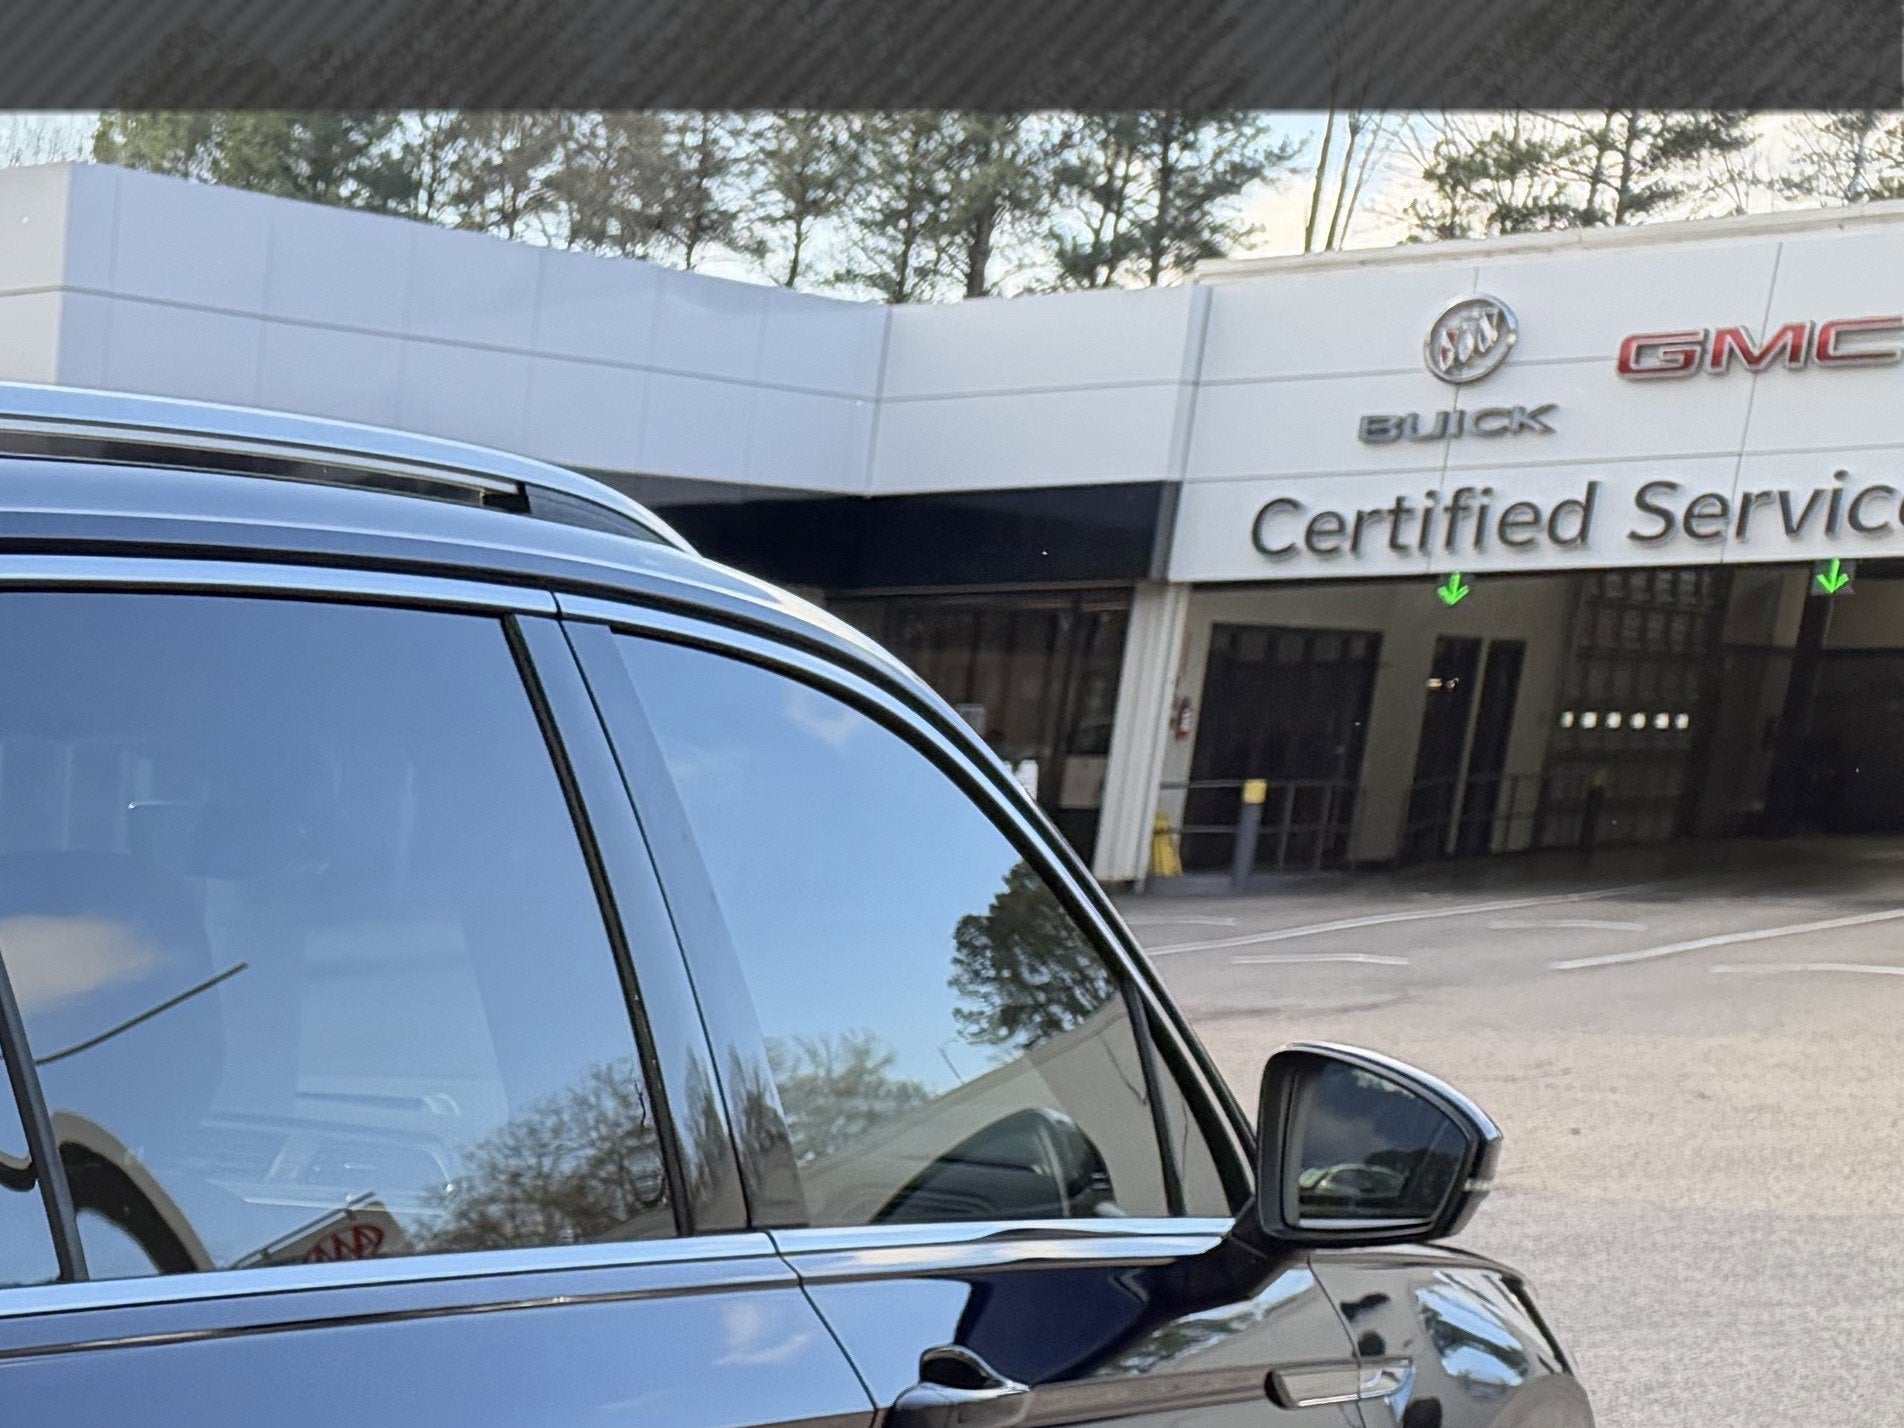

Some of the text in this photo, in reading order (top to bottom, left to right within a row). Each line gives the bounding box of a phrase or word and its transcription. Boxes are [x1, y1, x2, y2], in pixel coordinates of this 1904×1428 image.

[1615, 315, 1903, 380] GMC
[1357, 402, 1559, 445] BUICK
[1250, 468, 1904, 560] Certified Servic
